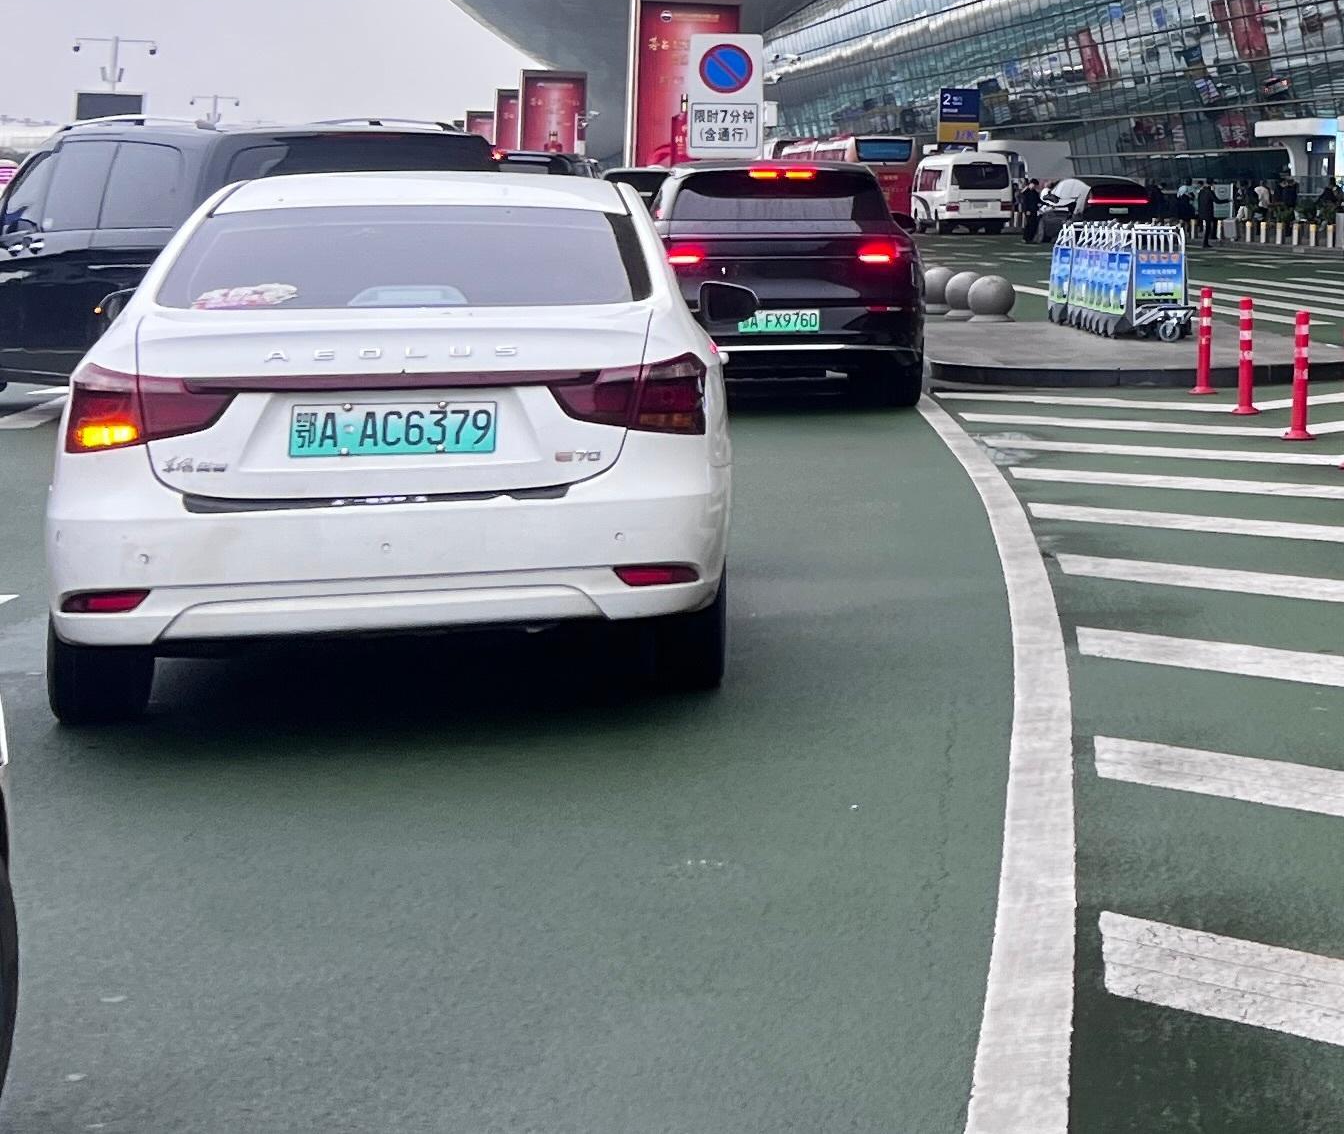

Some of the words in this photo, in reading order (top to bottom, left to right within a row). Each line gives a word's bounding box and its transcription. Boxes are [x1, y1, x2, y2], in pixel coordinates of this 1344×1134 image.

[942, 93, 952, 106] 2
[694, 109, 755, 124] 限时7分钟
[699, 127, 749, 143] (含通行)
[765, 312, 818, 329] FX9760
[263, 344, 520, 363] AEOLUS
[295, 411, 338, 450] 鄂A
[358, 408, 492, 449] AC6379
